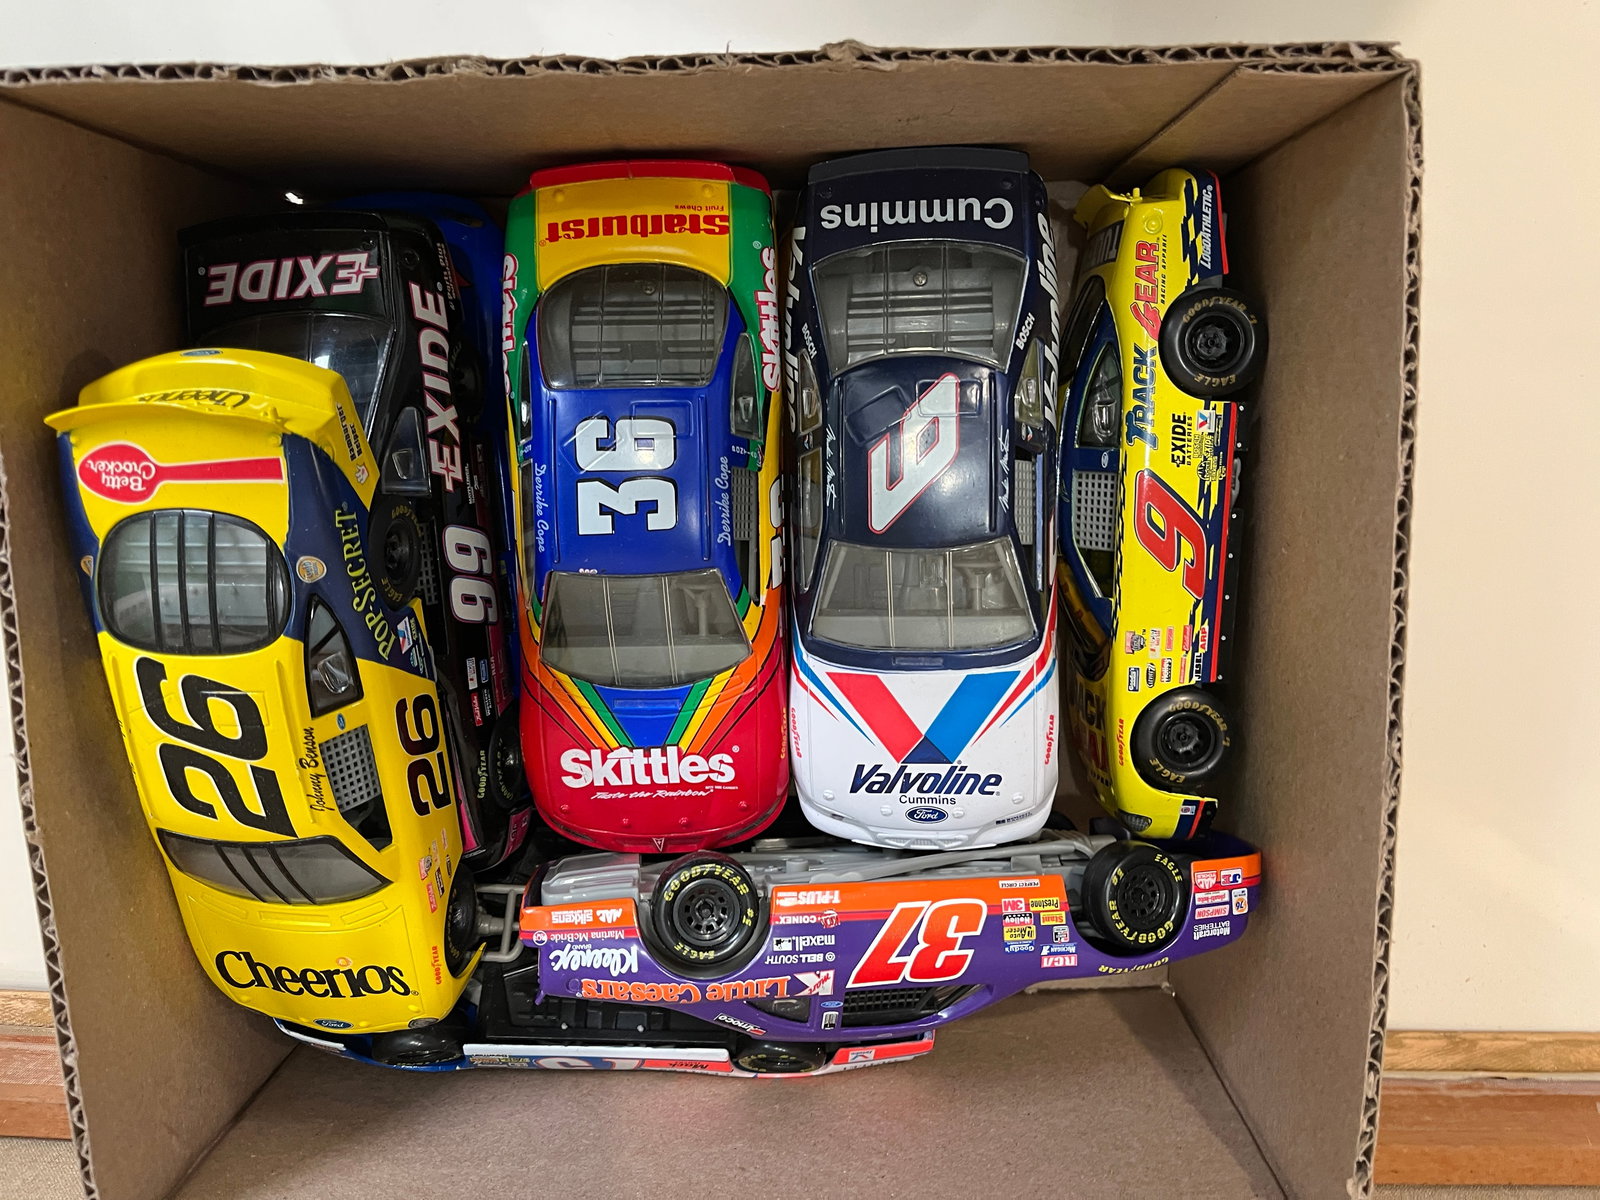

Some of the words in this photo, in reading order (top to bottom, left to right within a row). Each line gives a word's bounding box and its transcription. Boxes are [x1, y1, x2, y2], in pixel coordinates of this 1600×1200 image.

[674, 204, 703, 212] Chews
[704, 204, 725, 212] Fruit
[820, 198, 1014, 233] Cummins
[545, 214, 730, 242] Starburst
[1160, 234, 1168, 271] APPAREL
[202, 252, 380, 307] EXIDE
[1130, 240, 1161, 341] GEAR
[1182, 296, 1246, 323] GOODYEAR
[801, 322, 818, 359] BOSCH
[1016, 313, 1036, 350] BOSCH
[408, 281, 463, 493] EXIDE
[1126, 341, 1159, 450] TRACK
[1194, 373, 1236, 388] EAGLE
[336, 403, 357, 462] Hamburger
[349, 422, 364, 459] Helper
[1171, 413, 1187, 468] EXIDE
[87, 459, 156, 481] Crocker
[867, 372, 960, 535] 6
[101, 473, 147, 492] Betty
[575, 416, 677, 536] 36
[714, 456, 729, 492] Cope
[537, 517, 550, 553] Cope
[715, 494, 732, 546] Derrike
[1135, 467, 1207, 601] 9
[443, 524, 498, 623] 99
[1200, 627, 1208, 651] ARP
[791, 707, 802, 758] GOODYEAR
[1167, 701, 1228, 731] GOODYEAR
[133, 656, 300, 839] 26
[299, 726, 320, 770] Benson
[395, 693, 452, 816] 26
[1045, 714, 1055, 765] GOODYEAR
[1116, 718, 1125, 766] GOODYEAR
[477, 749, 486, 799] GOODYEAR
[560, 745, 736, 789] Skittles
[849, 763, 1003, 796] Valvoline
[1150, 758, 1186, 783] EAGLE
[629, 790, 652, 799] the
[652, 788, 711, 799] Rainbow
[899, 794, 957, 806] Cummins
[913, 809, 940, 820] Ford
[663, 864, 749, 901] GOODYEAR
[1154, 853, 1183, 882] EAGLE
[799, 890, 841, 904] T-PLUS
[1003, 900, 1023, 911] 3M
[1031, 898, 1059, 909] Prestone
[1197, 908, 1227, 918] SIMPSON
[1235, 901, 1245, 911] 76
[591, 930, 625, 940] Martina
[779, 915, 817, 924] COINEX
[1042, 915, 1064, 923] Stant
[1109, 900, 1174, 943] GOODYEAR
[1193, 920, 1230, 932] BATTERIES
[1193, 926, 1231, 940] Motorcraft
[550, 931, 589, 943] McBride
[674, 942, 715, 959] EAGLE
[845, 898, 988, 988] 37
[215, 950, 411, 998] Cheerios
[430, 945, 442, 985] GOODYEAR
[549, 943, 638, 977] Kleenex
[1043, 955, 1076, 967] RCA
[1098, 956, 1169, 974] GOODYEAR
[581, 979, 702, 1004] Caesars
[705, 976, 791, 1002] Little
[718, 1013, 758, 1032] Amoco
